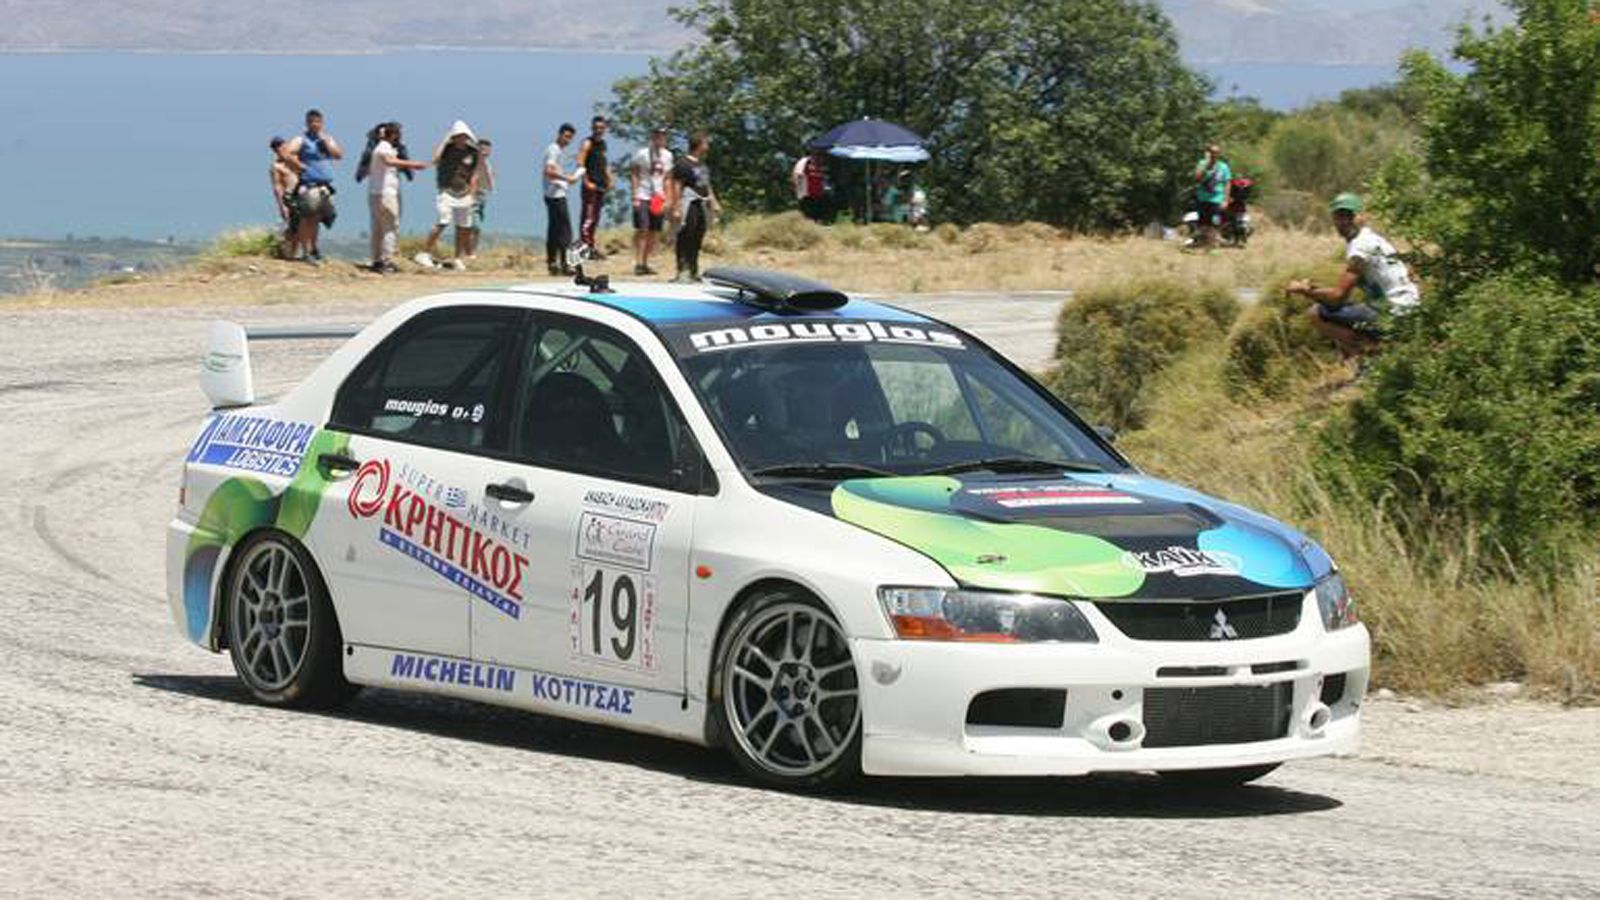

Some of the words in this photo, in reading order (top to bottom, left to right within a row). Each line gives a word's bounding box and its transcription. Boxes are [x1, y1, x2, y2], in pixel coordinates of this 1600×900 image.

[226, 449, 300, 476] LOGISTICS
[383, 484, 530, 601] ΚΡΗΤΙΚΟΣ
[467, 504, 531, 550] MARKET
[584, 569, 637, 661] 19
[391, 654, 516, 691] MICHELIN
[532, 674, 635, 715] ΚΟΤΙΤΣΑΣ
